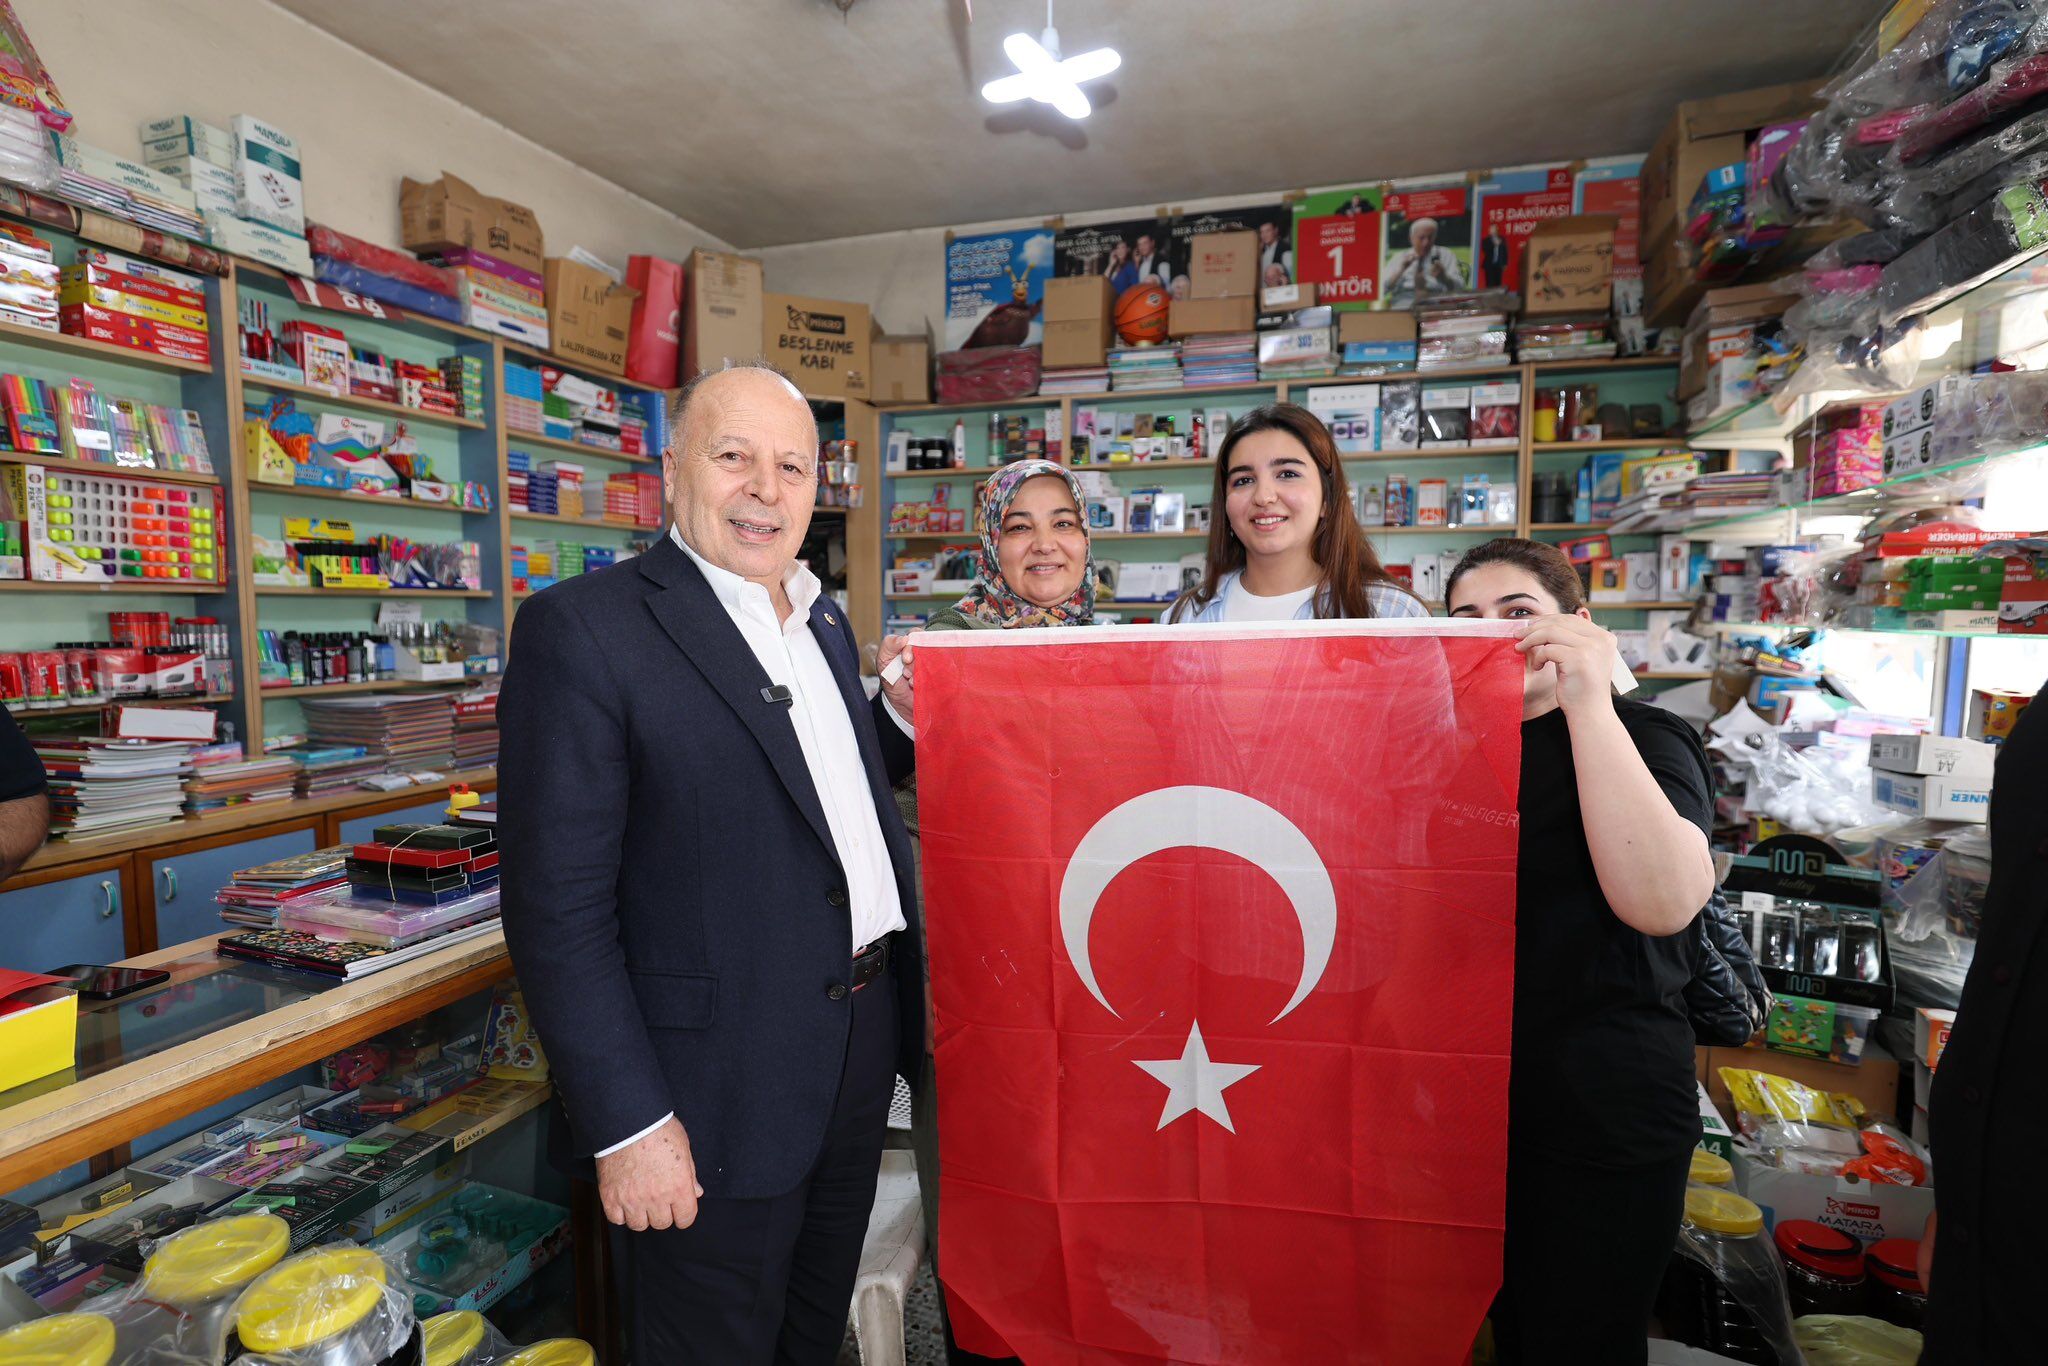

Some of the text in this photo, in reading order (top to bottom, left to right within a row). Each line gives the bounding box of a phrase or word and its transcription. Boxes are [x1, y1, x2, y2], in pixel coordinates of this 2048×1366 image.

[1489, 204, 1570, 222] 15 DAKİKASI
[1513, 221, 1537, 235] KO
[1327, 245, 1344, 278] 1
[778, 334, 854, 355] BESLENME
[1970, 616, 1998, 626] MANG
[1461, 803, 1519, 828] HILFIGER
[384, 1205, 398, 1219] 24
[1817, 1215, 1885, 1232] MATARA
